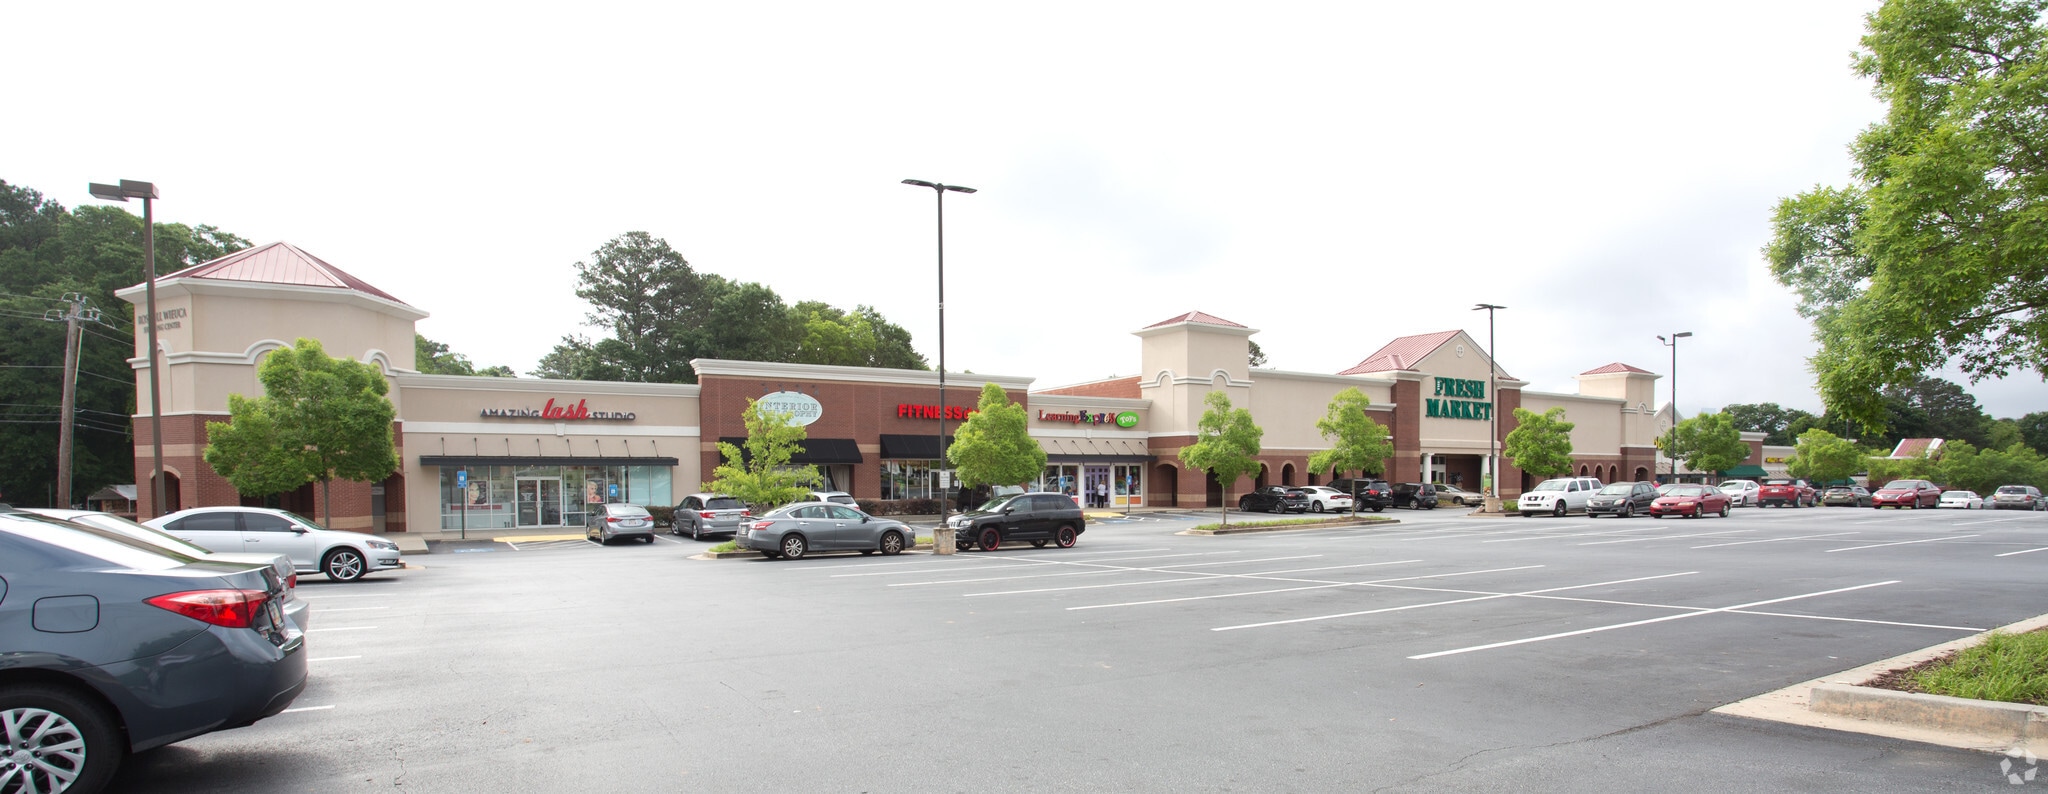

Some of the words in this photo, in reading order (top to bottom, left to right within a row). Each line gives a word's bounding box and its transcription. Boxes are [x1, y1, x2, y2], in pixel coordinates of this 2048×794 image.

[1434, 376, 1485, 399] FRESH
[480, 408, 540, 418] AMAZING
[541, 397, 590, 420] lash
[592, 411, 636, 421] STUDIO
[759, 401, 818, 411] NTERIOR
[1425, 398, 1491, 421] MARKET
